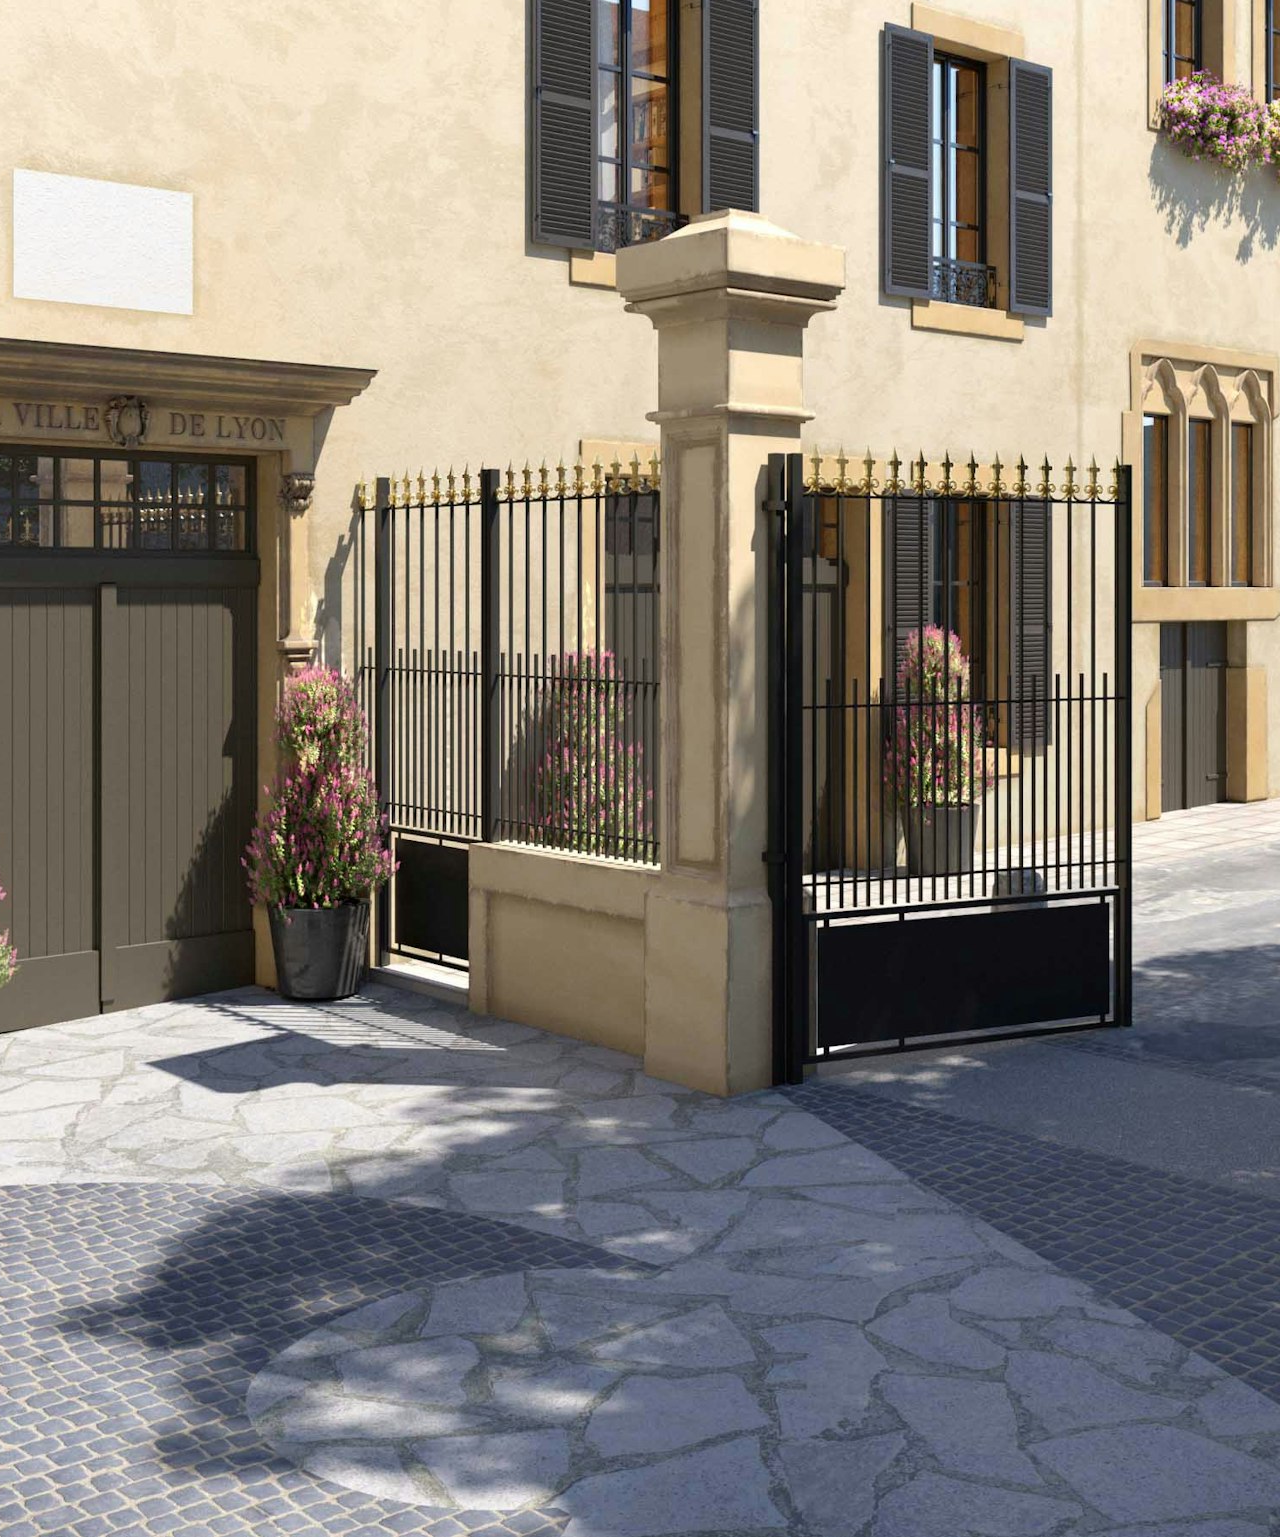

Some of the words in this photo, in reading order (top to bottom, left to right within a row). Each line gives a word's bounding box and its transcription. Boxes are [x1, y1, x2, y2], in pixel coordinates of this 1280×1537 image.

[12, 402, 100, 431] VILLE
[169, 412, 206, 437] DE
[216, 415, 286, 441] LYON
